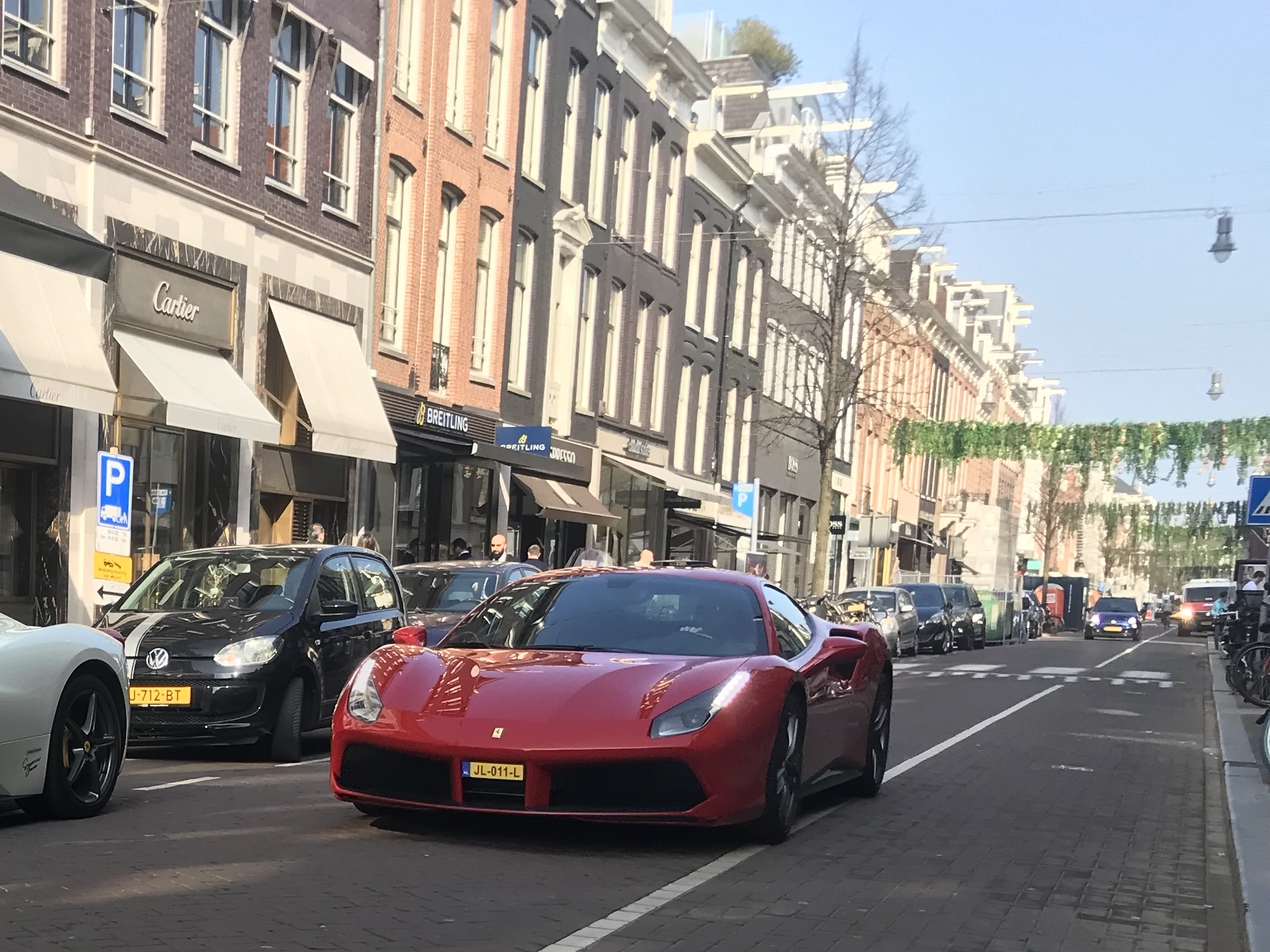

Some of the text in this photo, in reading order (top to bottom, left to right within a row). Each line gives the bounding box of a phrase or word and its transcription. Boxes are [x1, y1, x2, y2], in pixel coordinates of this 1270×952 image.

[152, 280, 200, 322] Cartier
[30, 380, 61, 402] Cartier
[426, 407, 469, 432] BREITLING
[105, 459, 126, 497] P
[737, 492, 749, 508] P
[473, 765, 520, 778] JL-011-L
